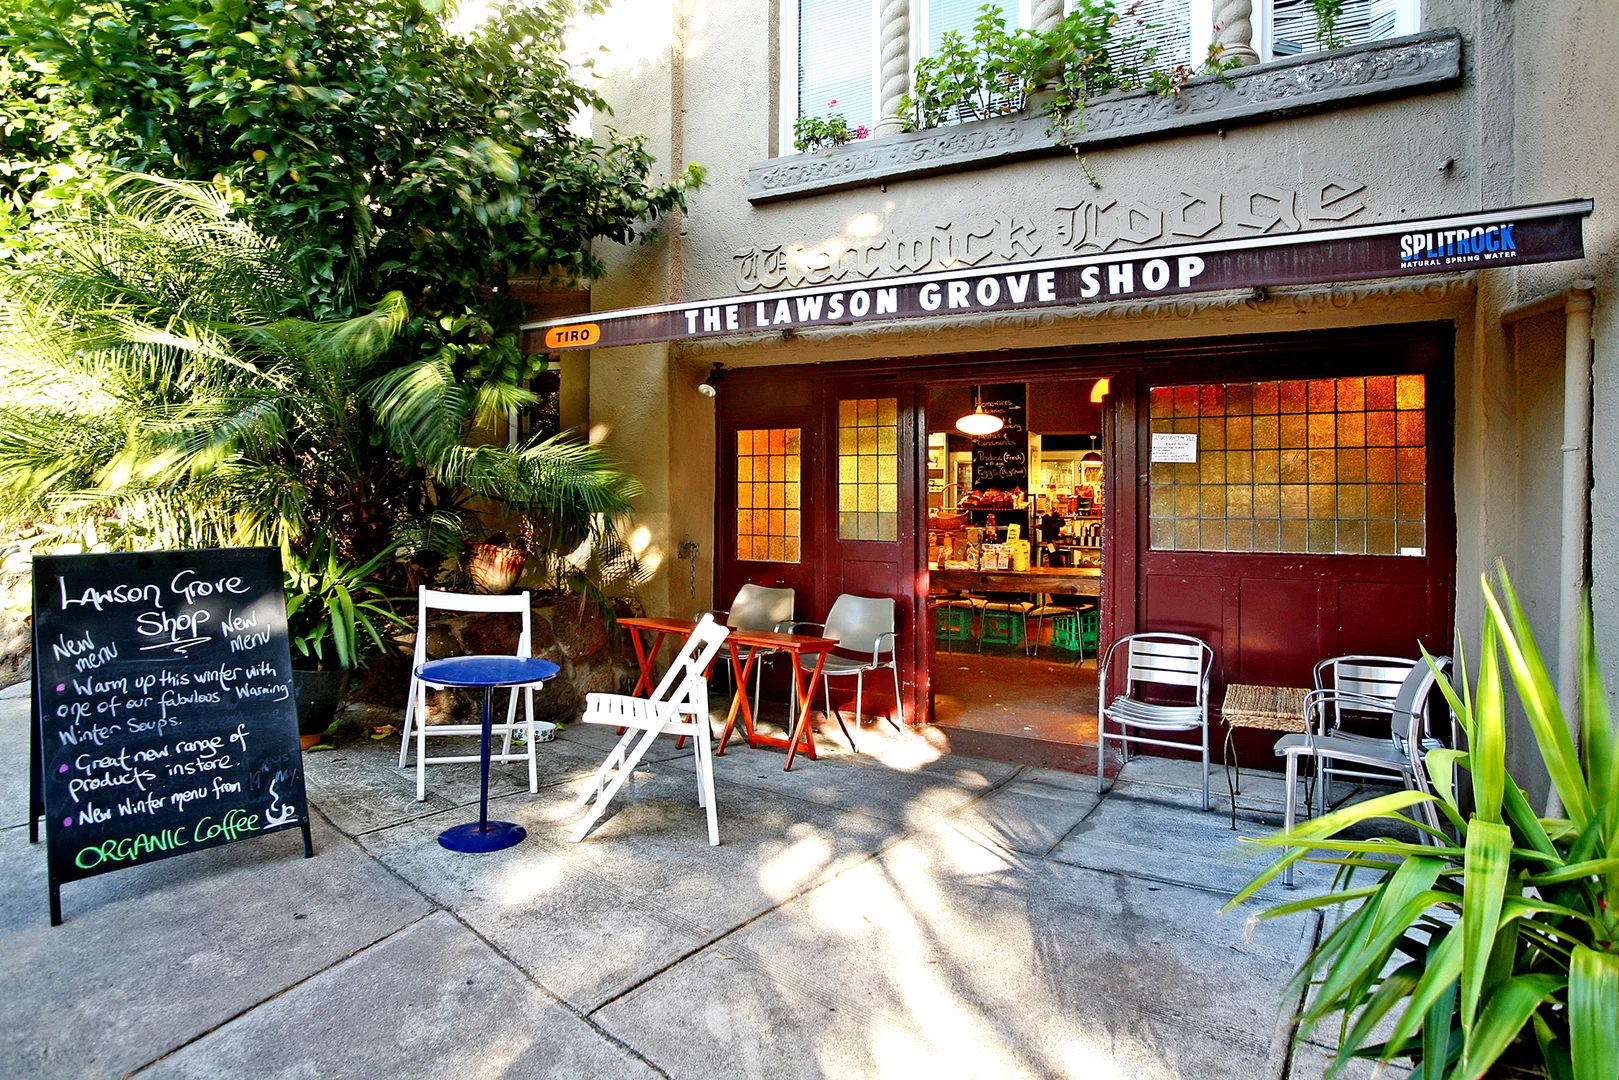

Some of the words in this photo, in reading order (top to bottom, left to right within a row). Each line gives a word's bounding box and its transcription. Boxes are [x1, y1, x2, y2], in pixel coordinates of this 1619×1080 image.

[732, 208, 1043, 292] Warwick
[1054, 174, 1367, 252] Lodge
[1401, 223, 1517, 261] SPLITROCK
[1401, 258, 1441, 269] NATURAL
[1445, 254, 1480, 264] SPRING
[1484, 251, 1517, 261] WATER
[684, 304, 741, 334] THE
[757, 287, 898, 327] LAWSON
[919, 270, 1057, 311] GROVE
[1080, 256, 1206, 299] SHOP
[555, 329, 590, 343] TIRO
[171, 569, 251, 605] Grove
[137, 609, 210, 642] Shop
[221, 608, 257, 638] New
[52, 630, 95, 661] New
[73, 675, 128, 695] Warm
[135, 674, 156, 695] up
[158, 669, 190, 687] this
[194, 662, 243, 692] winter
[245, 661, 277, 679] with
[56, 702, 92, 726] one
[96, 696, 121, 717] of
[126, 697, 153, 710] our
[158, 689, 221, 719] fabulous
[58, 724, 121, 746] Winter
[75, 746, 133, 777] Great
[133, 744, 169, 762] new
[175, 736, 225, 759] range
[230, 723, 250, 752] of
[69, 767, 157, 803] products
[79, 801, 113, 826] New
[118, 791, 166, 815] Winter
[171, 787, 208, 812] menu
[211, 776, 242, 800] from
[75, 826, 189, 870] ORGANIC
[193, 808, 261, 843] Coffee
